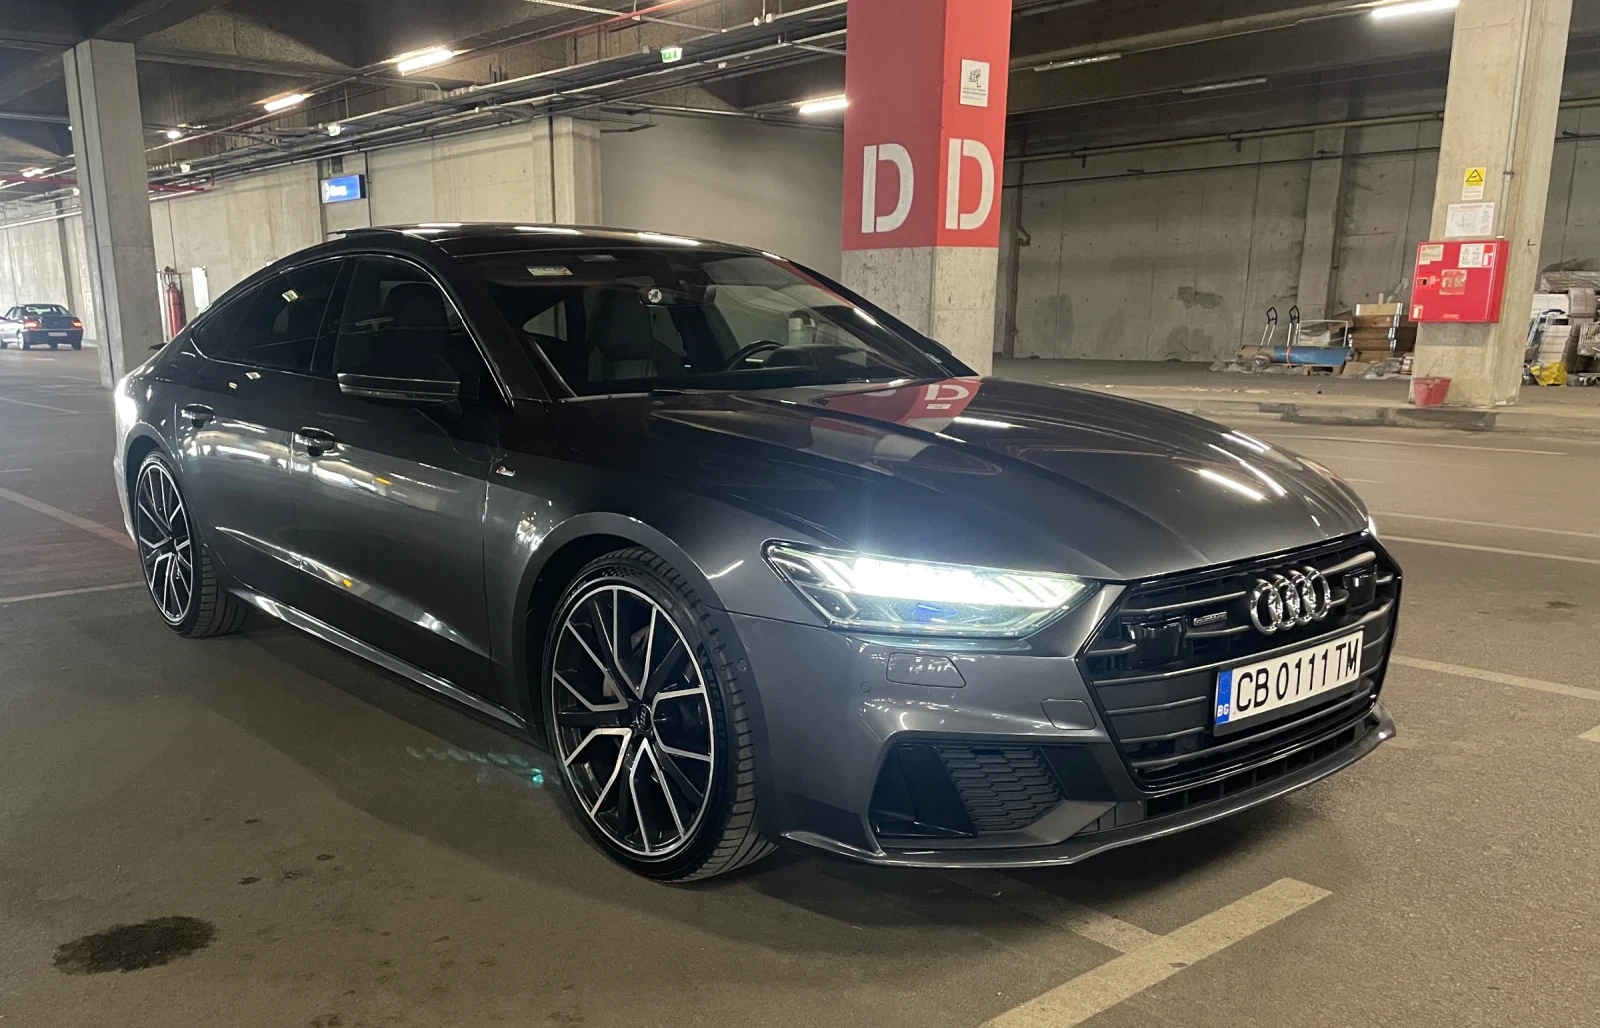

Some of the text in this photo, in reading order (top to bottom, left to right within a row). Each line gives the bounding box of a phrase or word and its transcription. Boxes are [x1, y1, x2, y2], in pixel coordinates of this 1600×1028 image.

[861, 143, 914, 233] D
[945, 138, 995, 230] D
[1217, 703, 1229, 718] BG
[1236, 638, 1359, 712] CB 0111 TM
